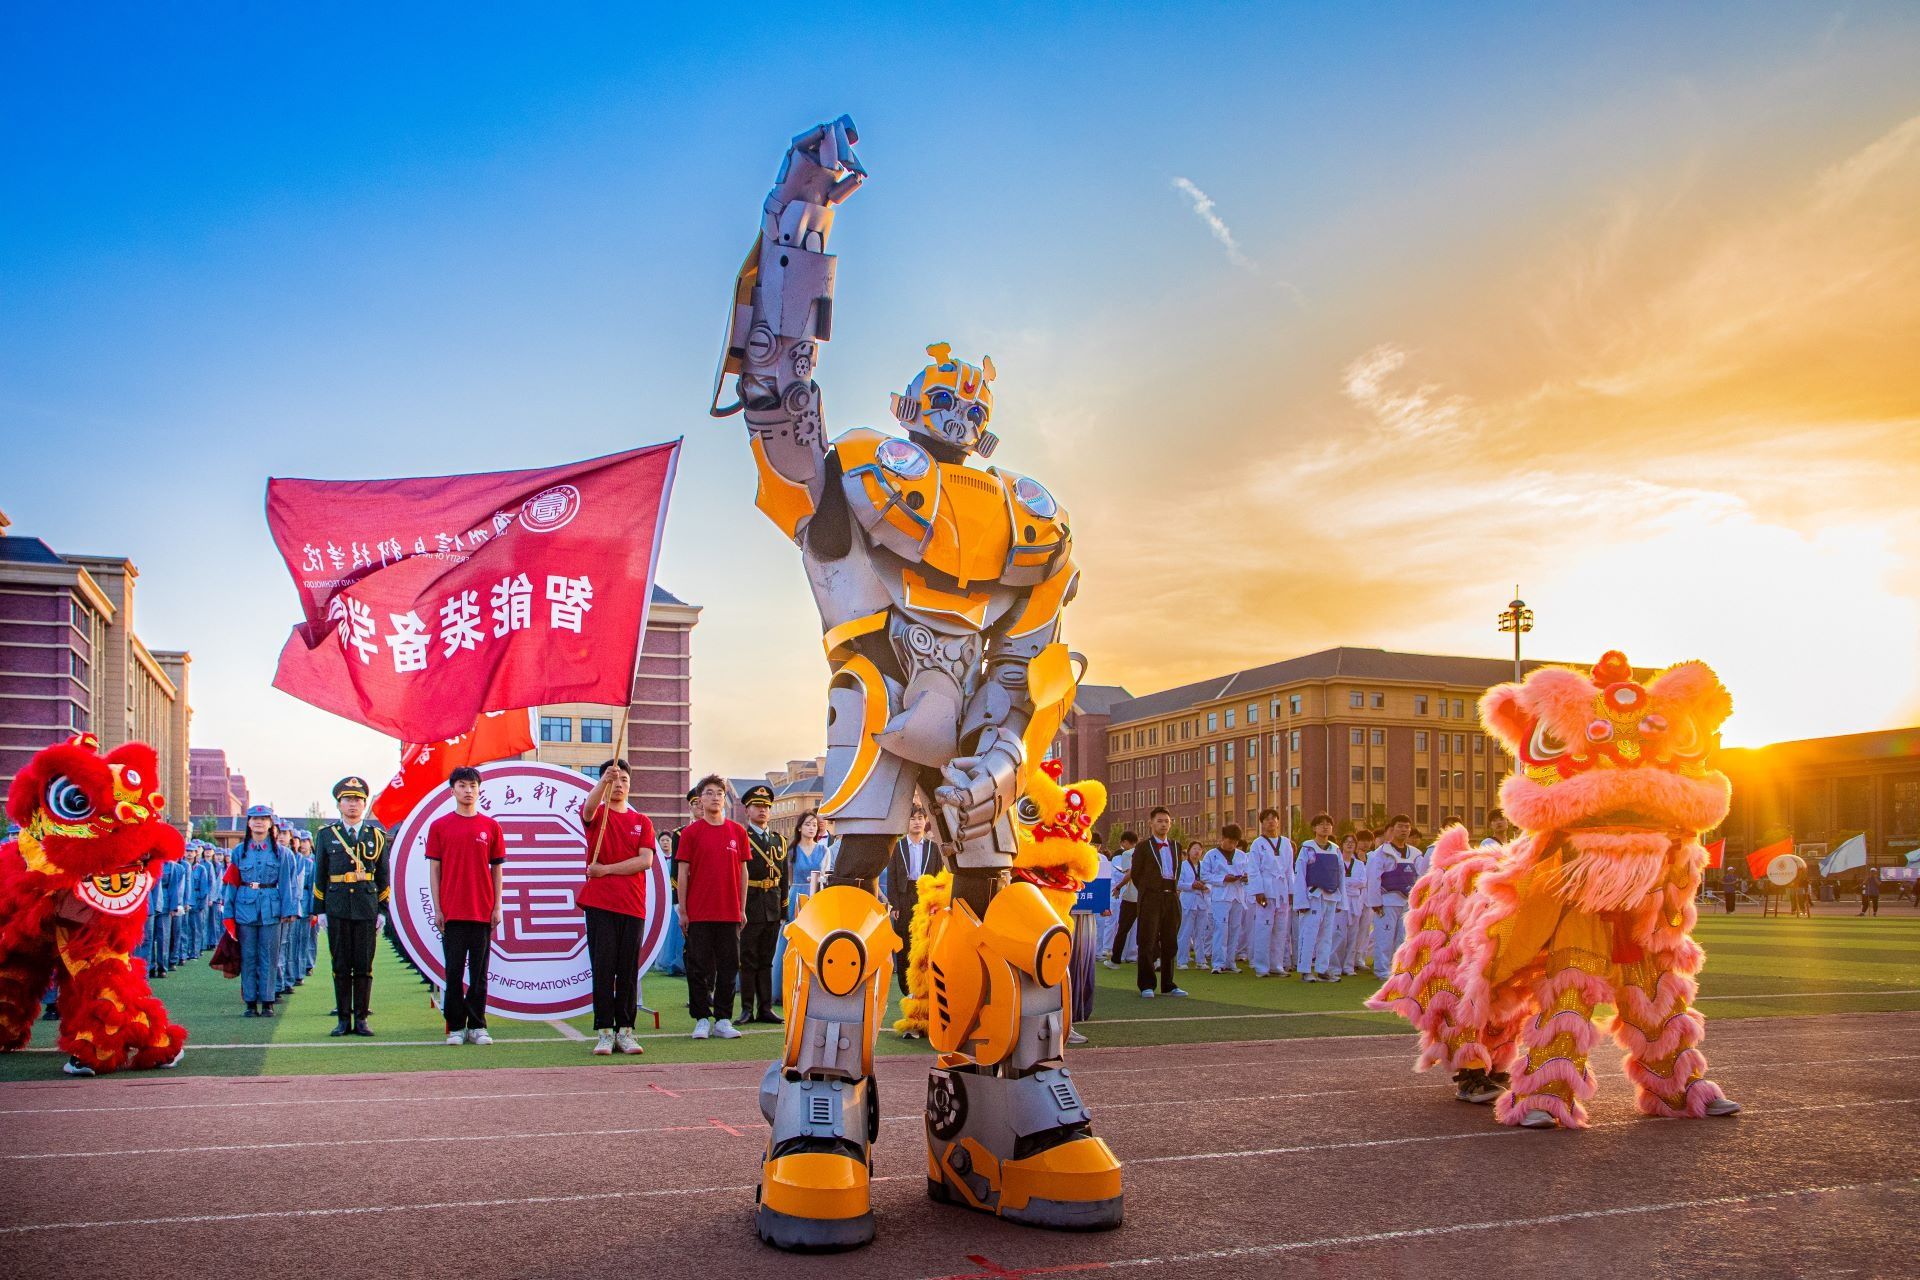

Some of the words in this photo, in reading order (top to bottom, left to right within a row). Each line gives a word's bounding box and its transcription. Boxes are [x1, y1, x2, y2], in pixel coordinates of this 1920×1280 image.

[486, 971, 500, 981] OF
[499, 975, 571, 991] INFORMATION
[571, 967, 593, 985] SCIE
